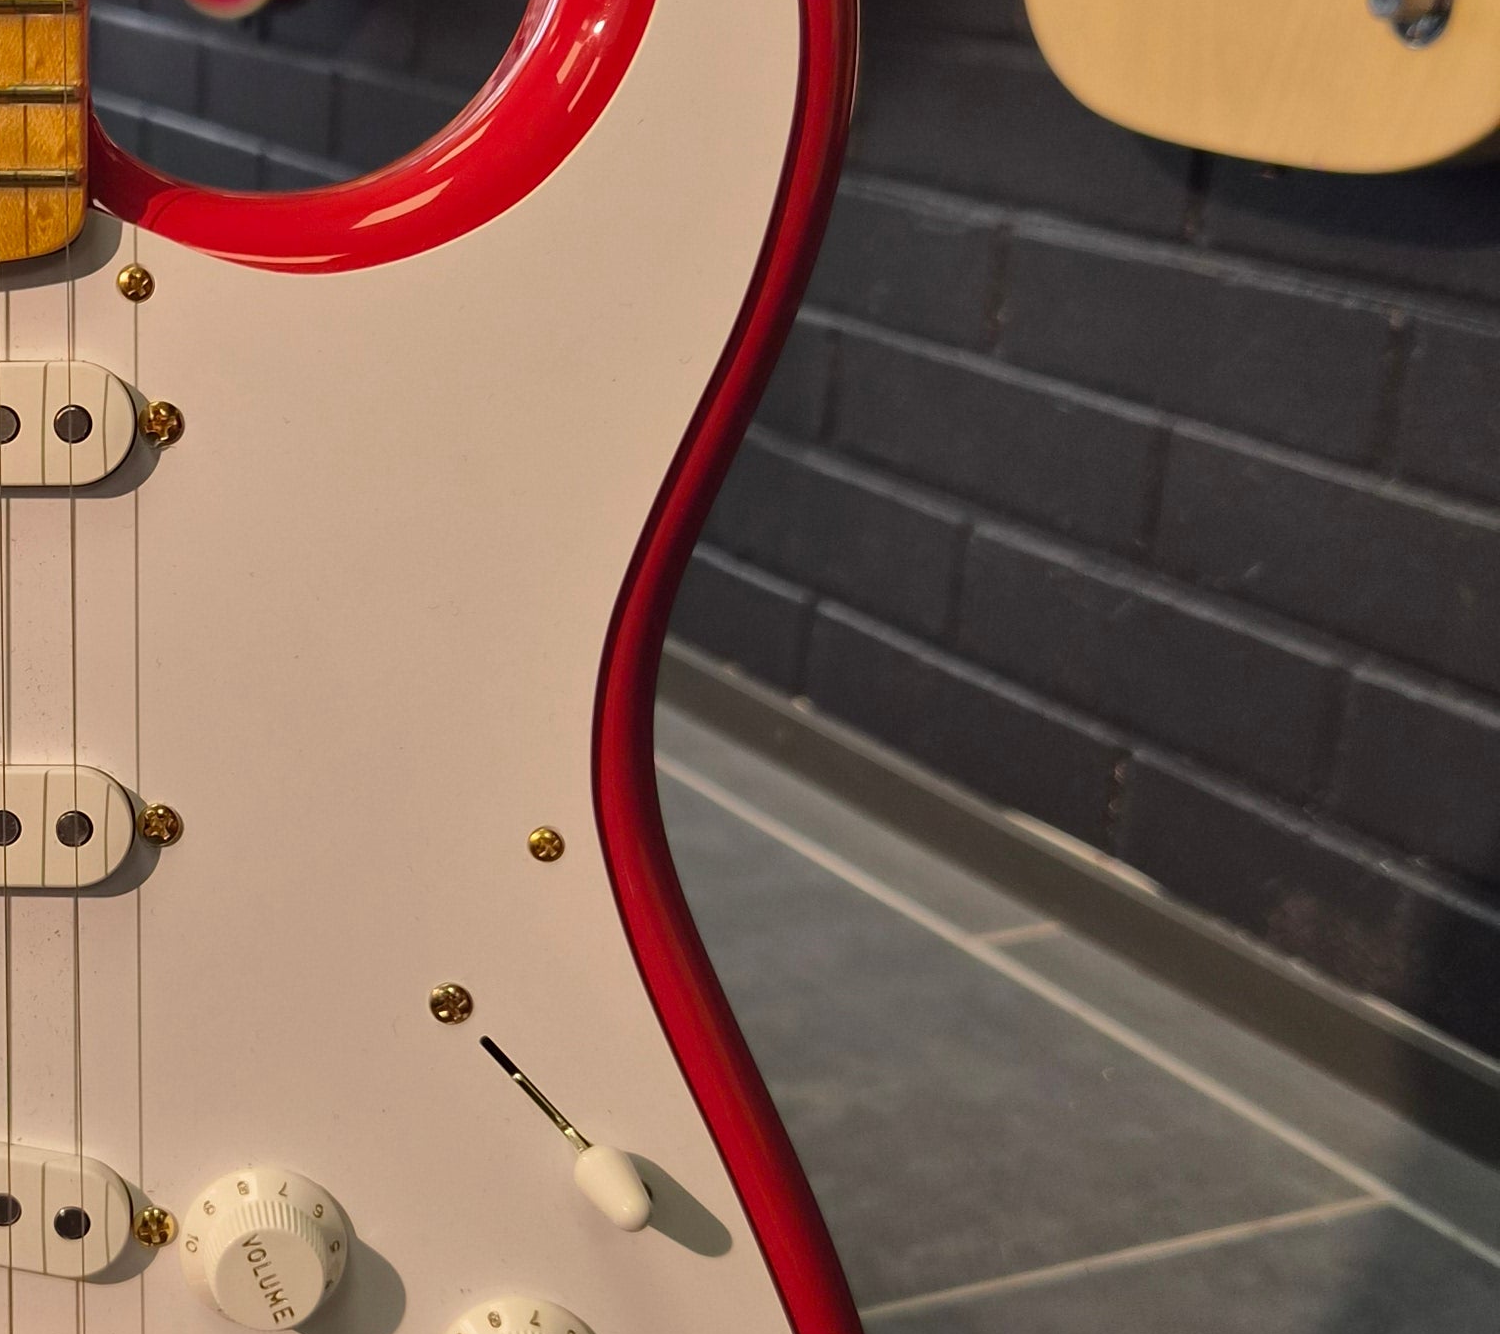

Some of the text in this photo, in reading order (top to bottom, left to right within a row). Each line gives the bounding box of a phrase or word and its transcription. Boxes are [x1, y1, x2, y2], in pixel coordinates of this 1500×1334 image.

[278, 1182, 289, 1197] 7
[312, 1204, 324, 1219] 6
[185, 1233, 199, 1253] 10
[241, 1232, 295, 1324] VOLUME
[529, 1310, 541, 1327] 7
